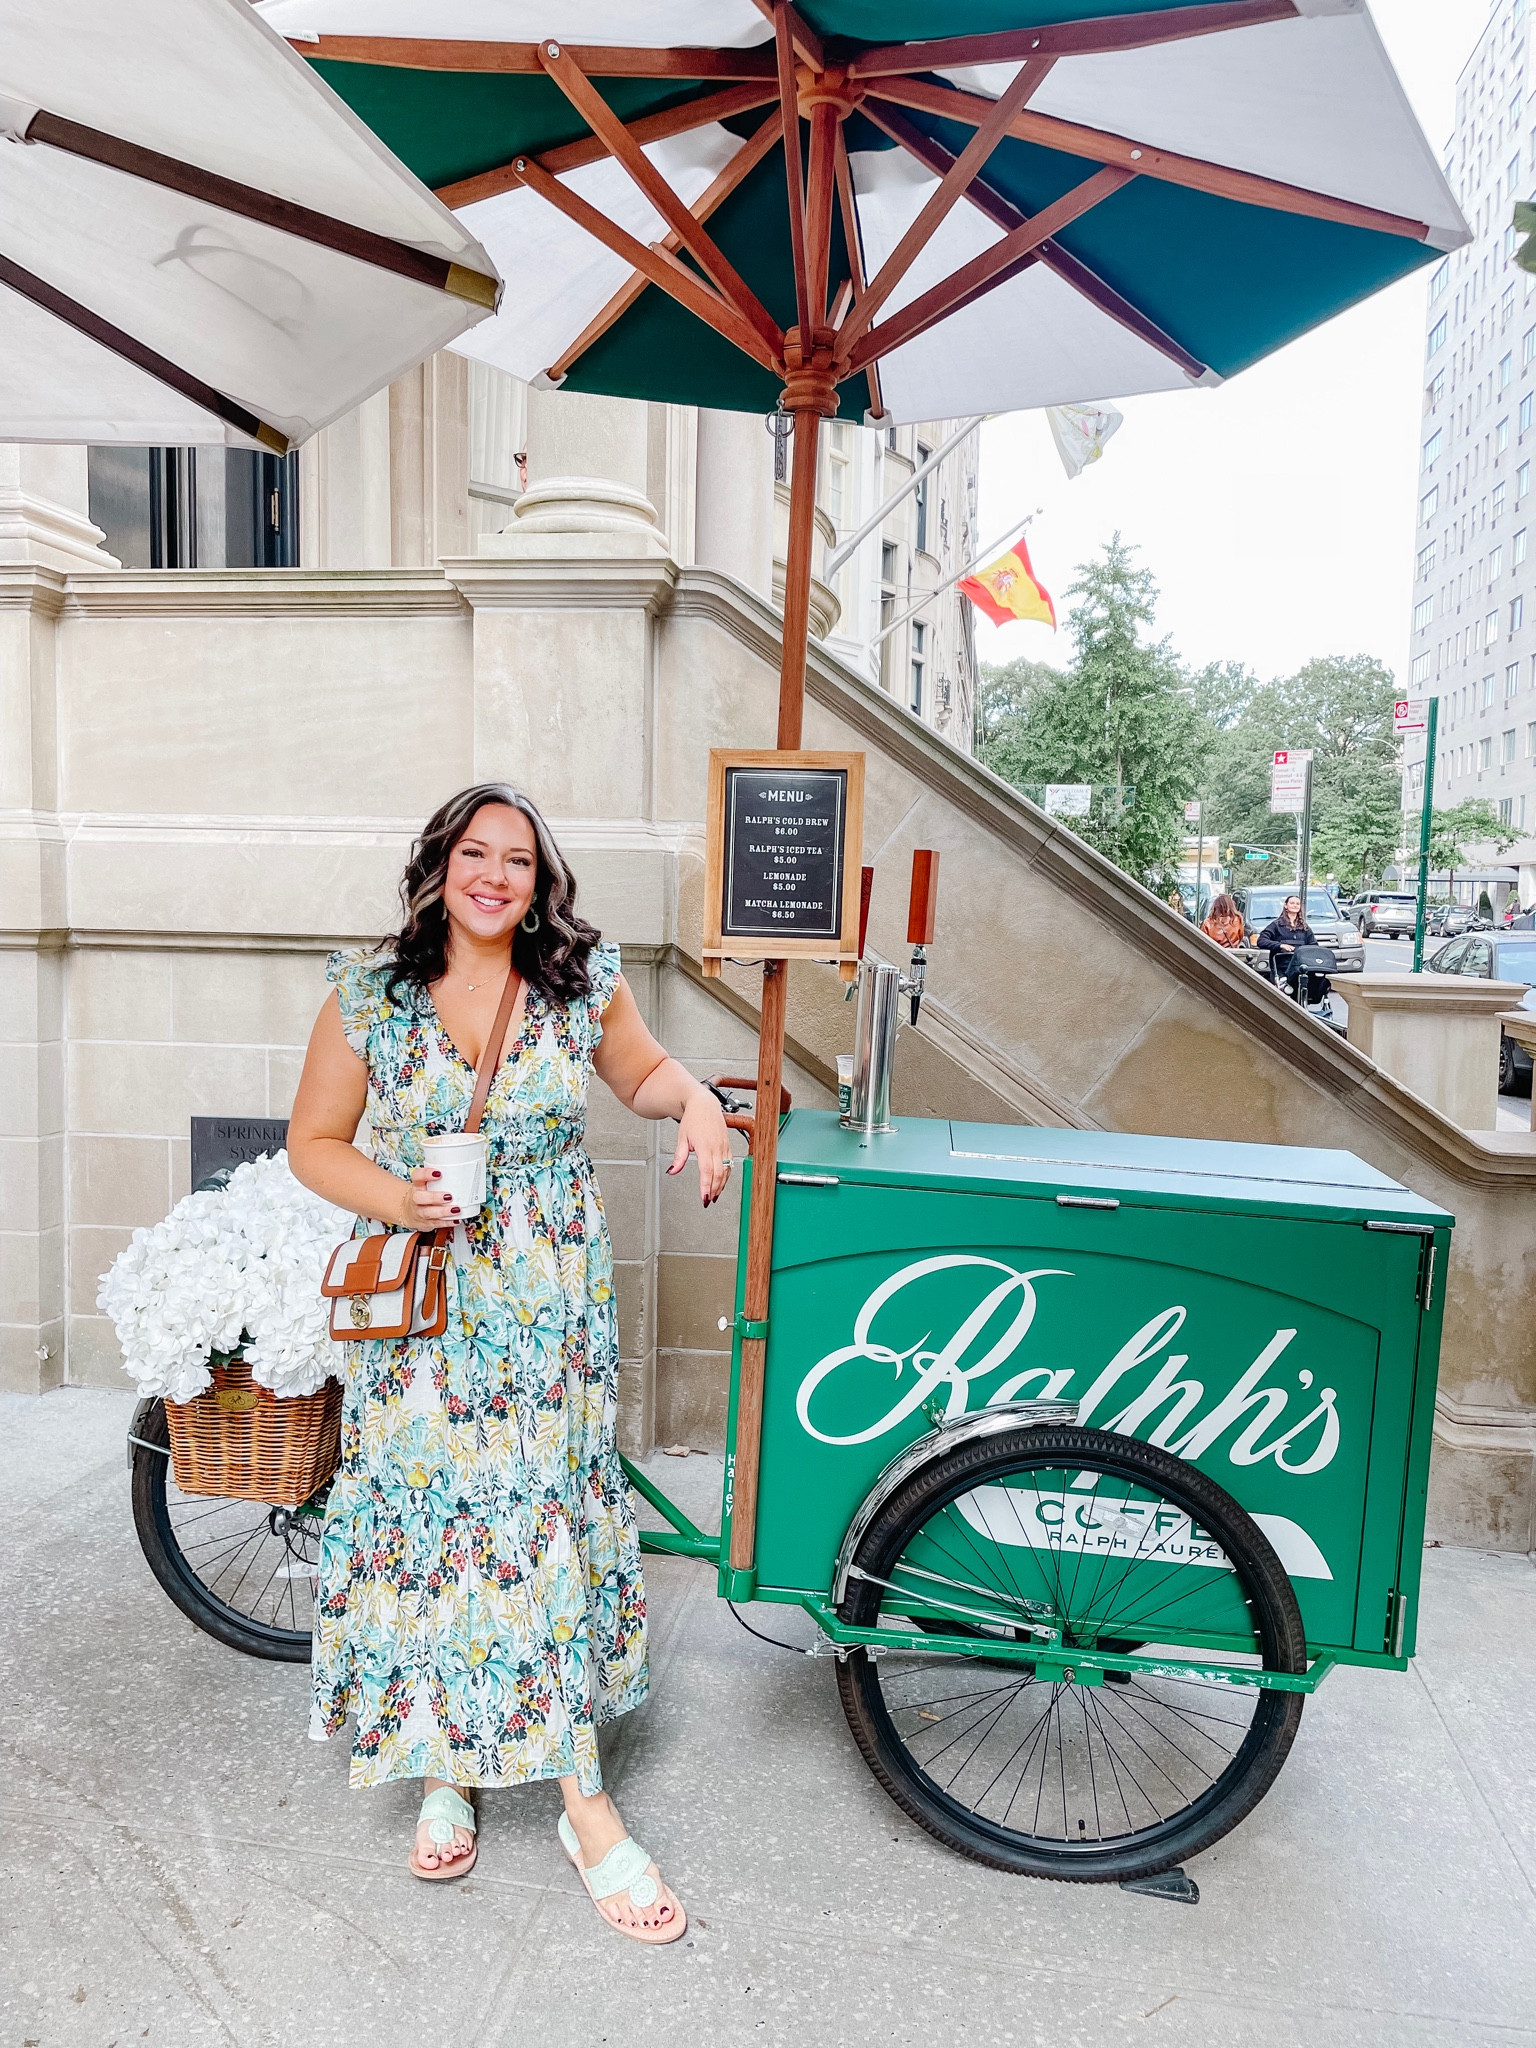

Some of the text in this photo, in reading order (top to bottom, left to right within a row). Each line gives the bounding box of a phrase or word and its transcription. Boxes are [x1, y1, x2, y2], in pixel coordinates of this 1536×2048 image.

[767, 790, 804, 802] MENU
[745, 816, 829, 826] RALPH'S COLD BREW
[775, 827, 798, 835] $6.00
[749, 844, 823, 855] RALPH'S ICED TEA
[773, 856, 797, 864] $5.00
[763, 872, 807, 881] LEMONADE
[772, 882, 796, 891] $5.00
[744, 899, 823, 910] MATCHA LEMONADE
[771, 910, 795, 919] $6.50
[217, 1126, 286, 1141] SPRINKL
[725, 1453, 737, 1517] Haley
[1050, 1531, 1228, 1560] RALPH LAURE
